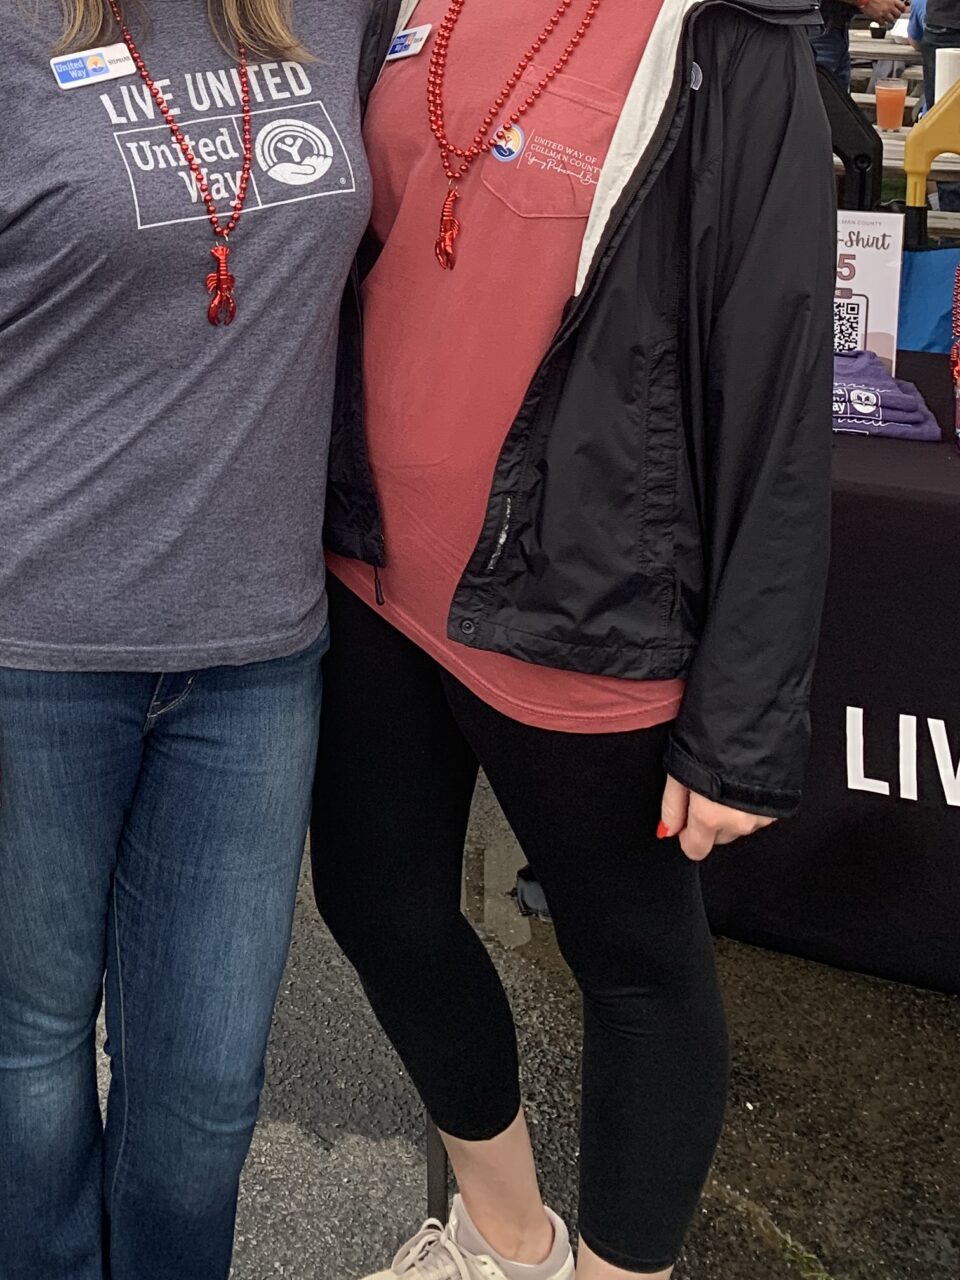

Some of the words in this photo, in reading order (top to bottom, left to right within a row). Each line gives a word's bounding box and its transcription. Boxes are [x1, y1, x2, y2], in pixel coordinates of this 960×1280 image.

[55, 59, 84, 73] United
[69, 69, 87, 79] Way
[99, 78, 181, 125] LIVE
[184, 61, 313, 112] UNITED
[126, 127, 240, 171] United
[530, 143, 569, 162] CULLMAN
[534, 135, 564, 151] UNITED
[565, 146, 584, 159] WAY
[585, 155, 597, 164] OF
[178, 168, 244, 207] Way
[837, 230, 892, 250] -Shirt
[833, 401, 846, 414] ay
